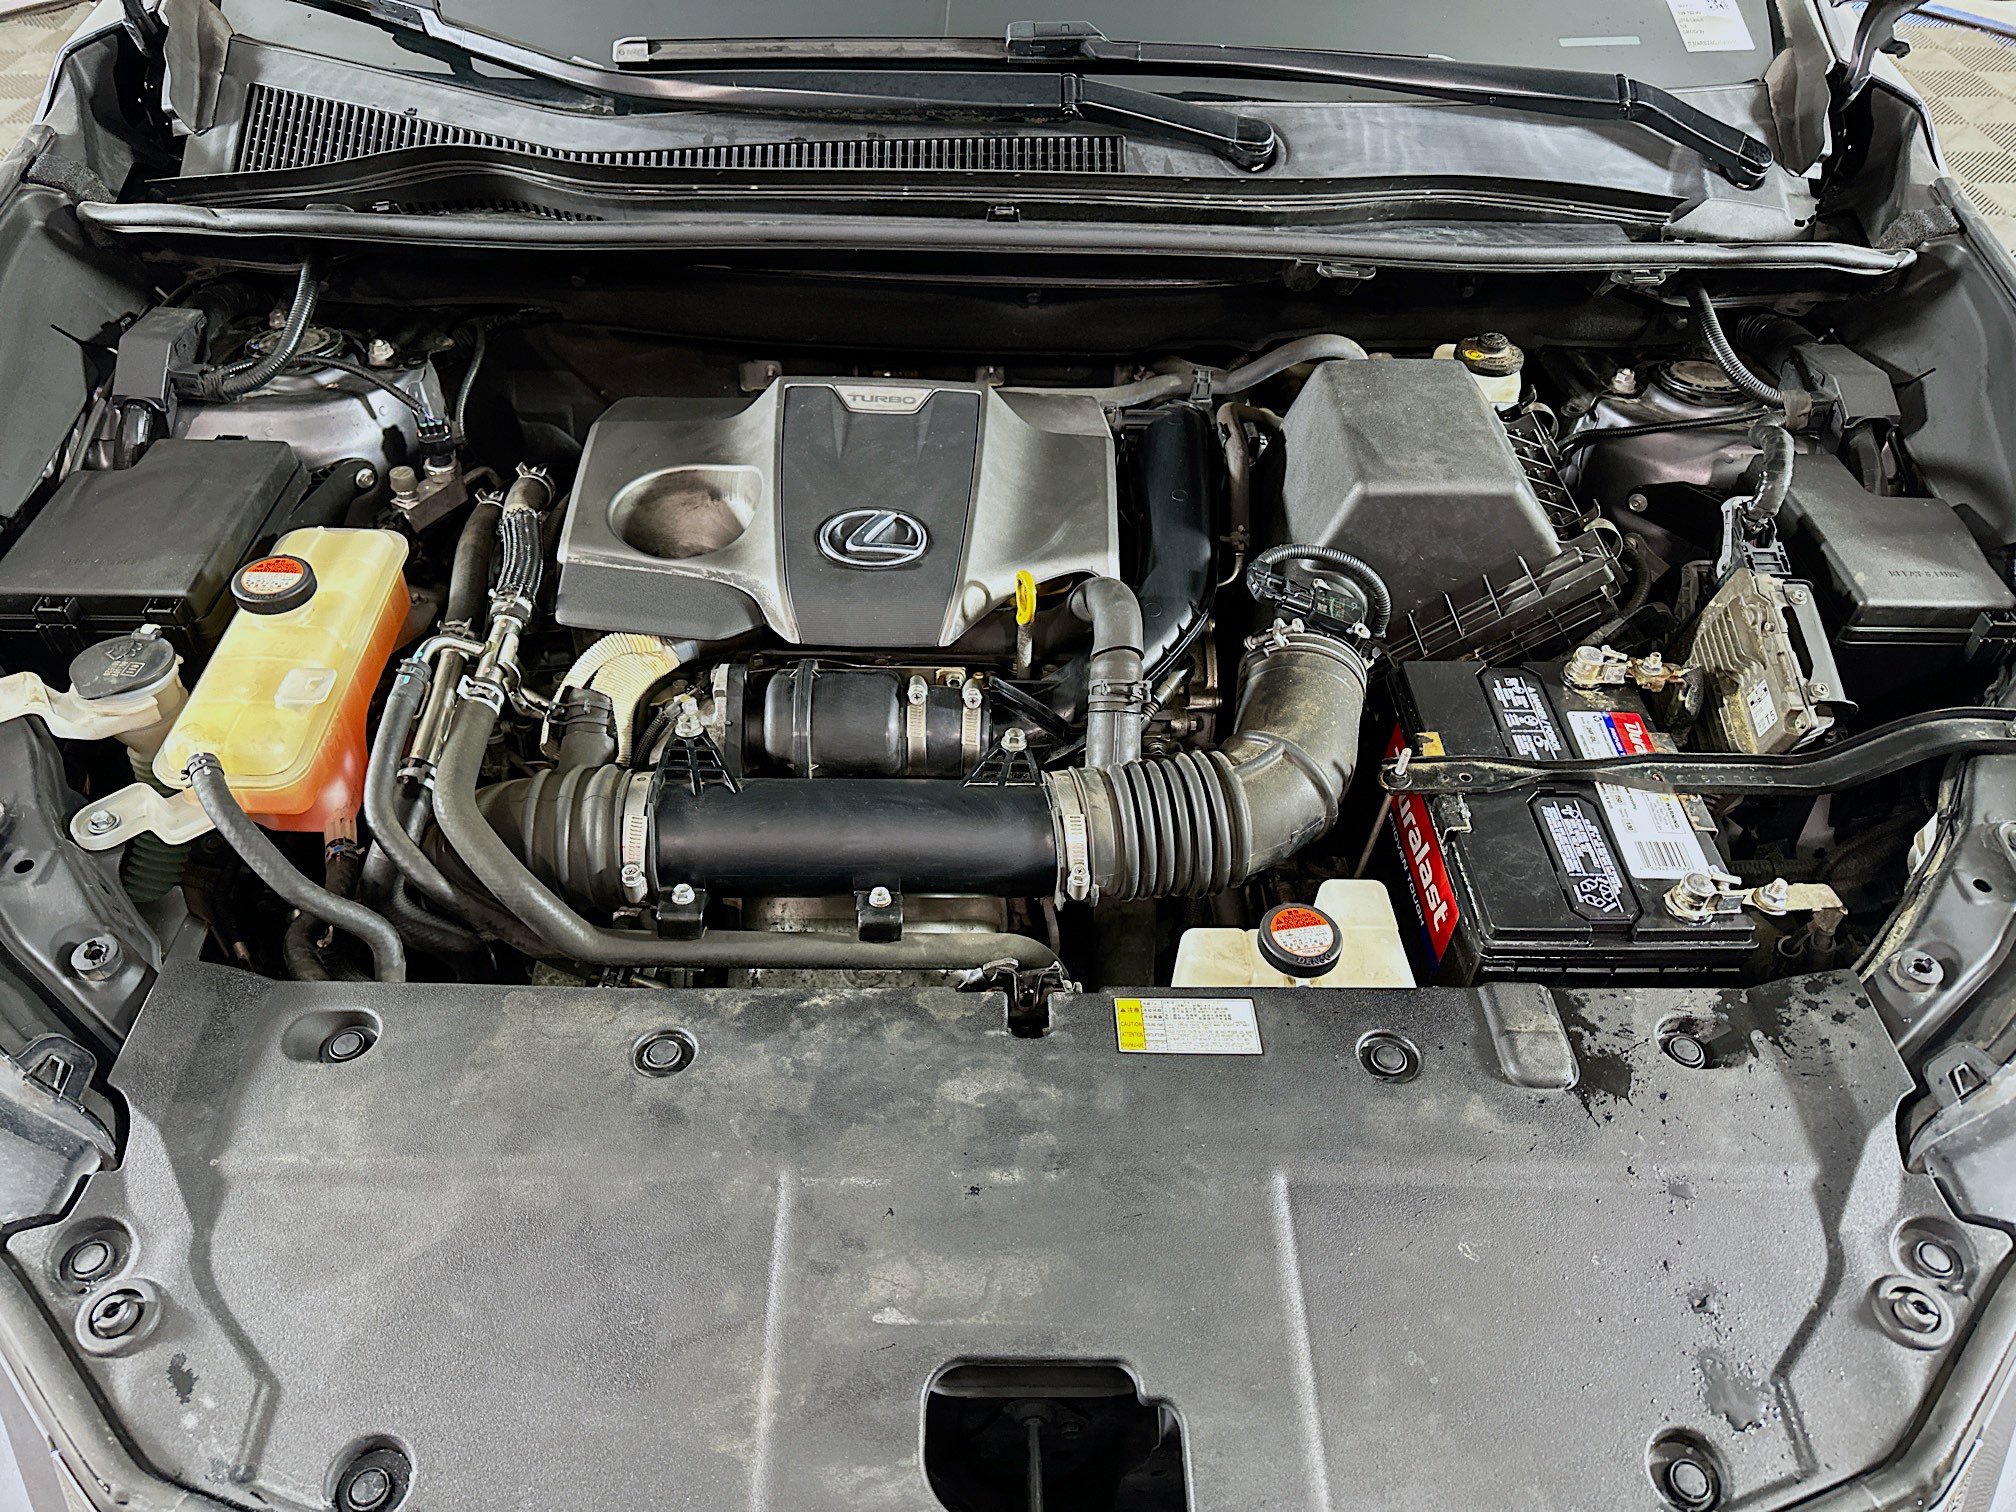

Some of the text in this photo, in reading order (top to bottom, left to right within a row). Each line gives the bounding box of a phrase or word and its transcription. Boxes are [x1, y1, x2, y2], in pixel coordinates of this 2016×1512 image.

[847, 394, 916, 404] TURBO
[1388, 812, 1425, 927] PROVEN TOUGH
[1397, 794, 1449, 933] uralast
[1297, 953, 1331, 965] DENSO
